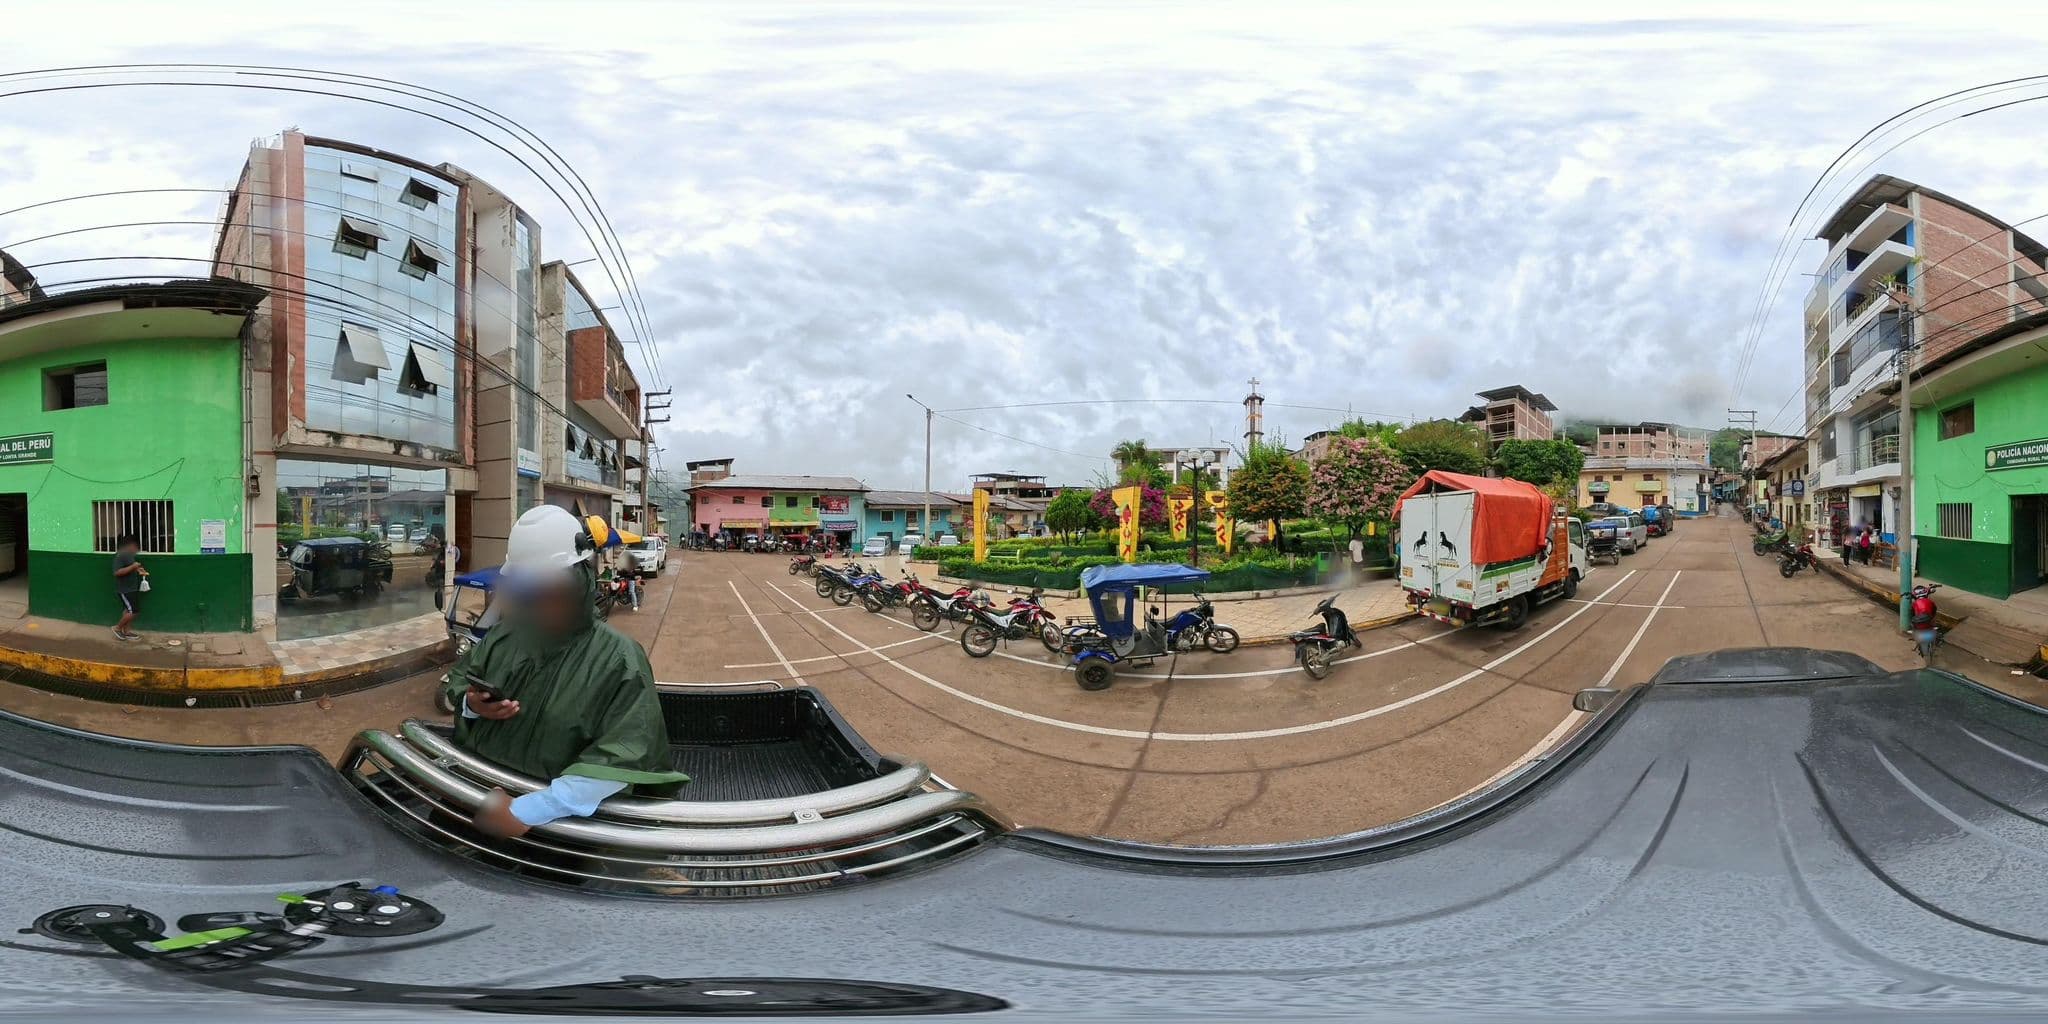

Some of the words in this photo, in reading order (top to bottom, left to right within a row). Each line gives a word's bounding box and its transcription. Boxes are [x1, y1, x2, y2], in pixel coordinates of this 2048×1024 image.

[12, 441, 26, 451] DEL
[29, 437, 51, 449] PERÚ
[1997, 446, 2021, 459] POLICÍA
